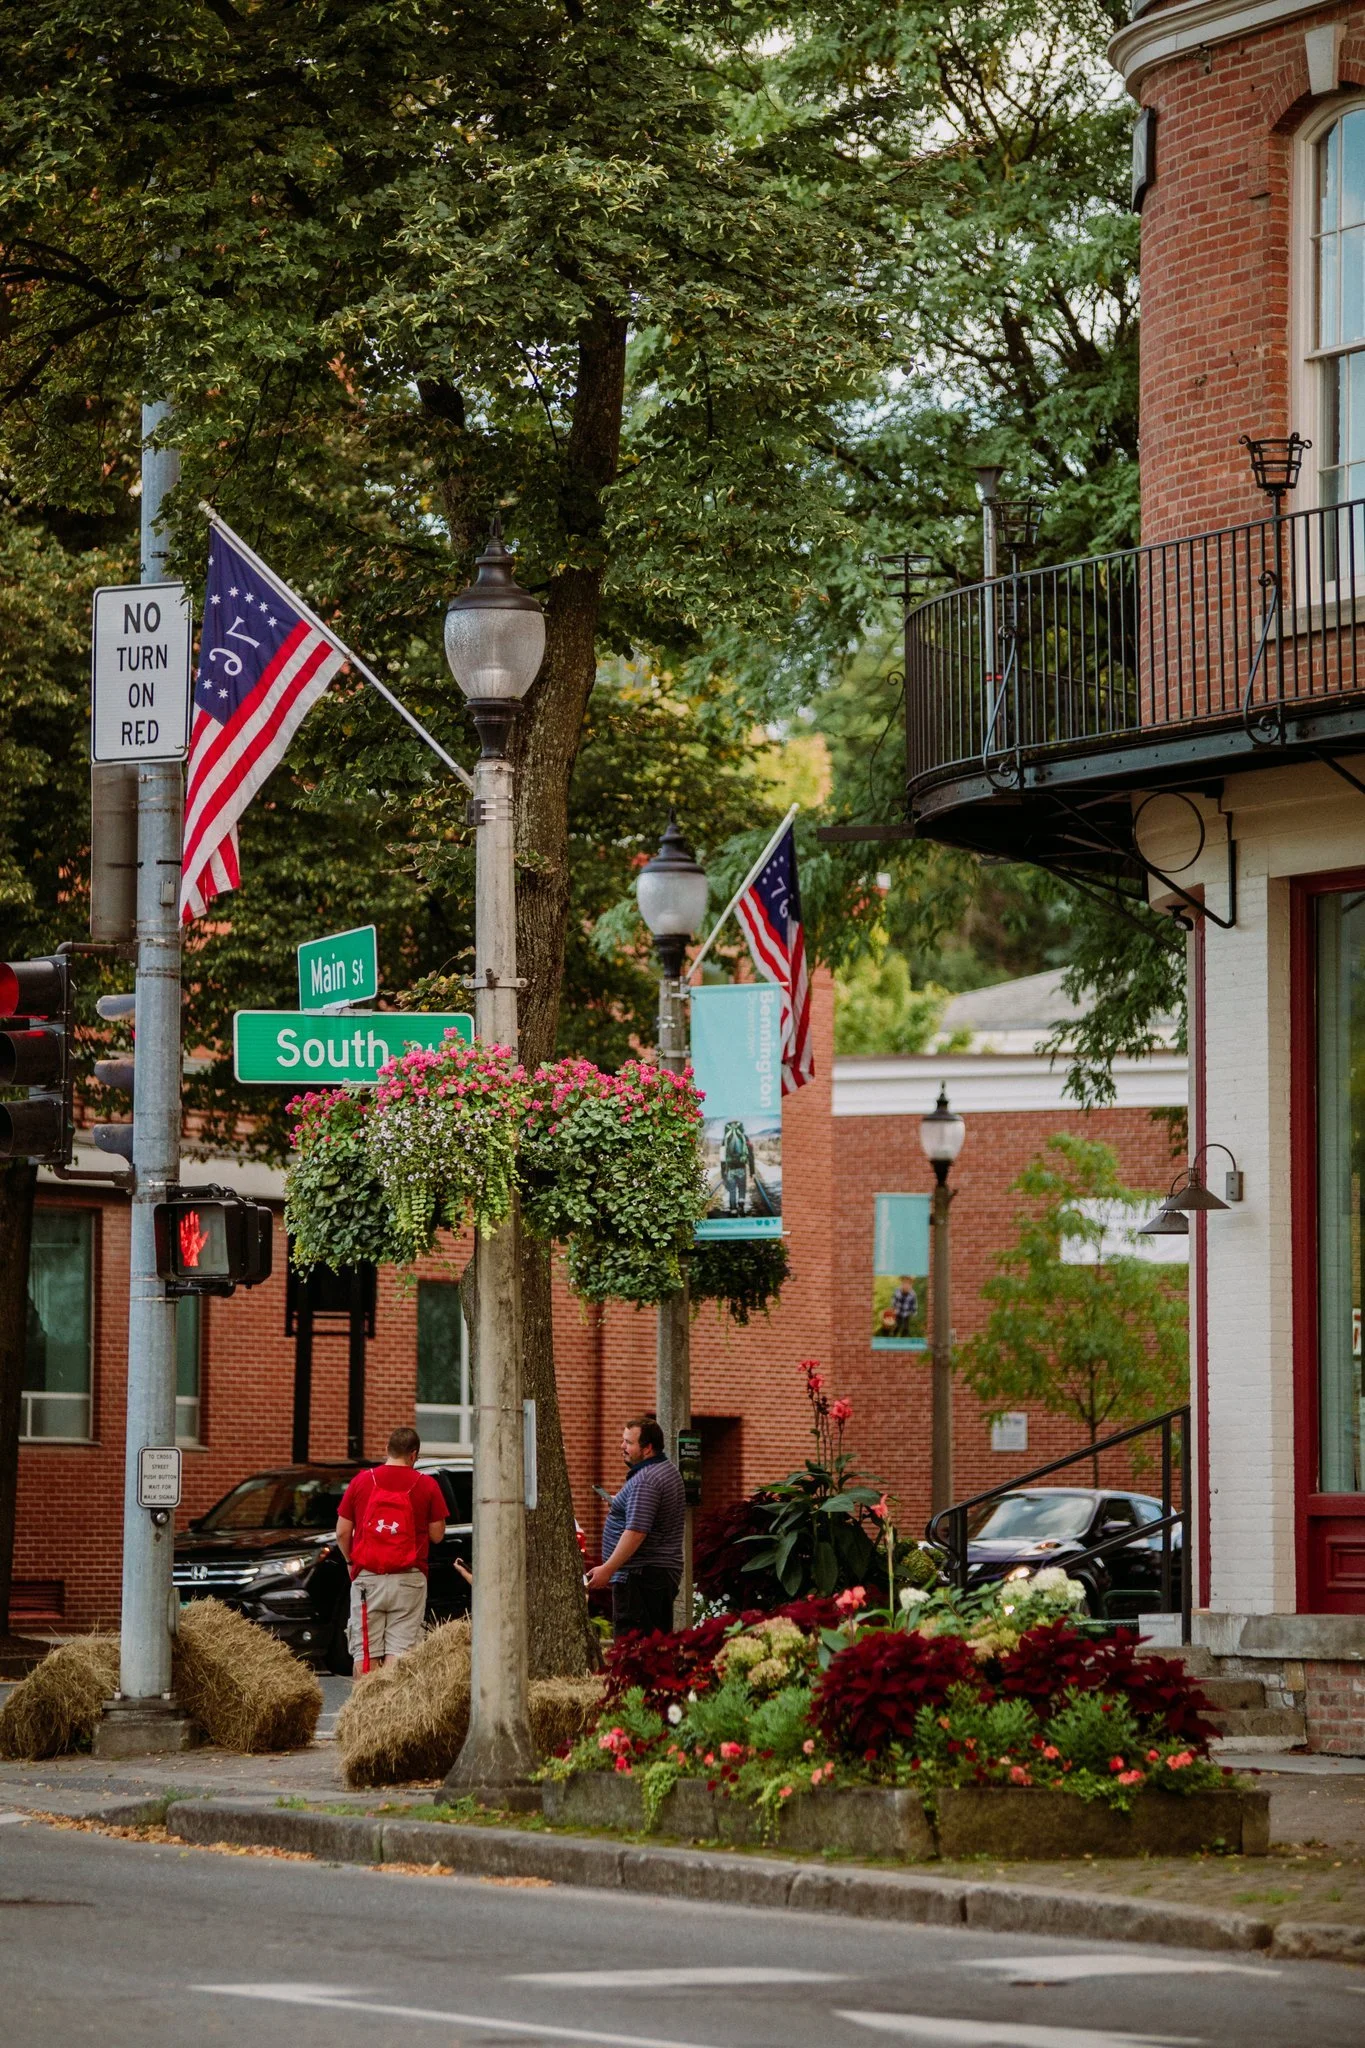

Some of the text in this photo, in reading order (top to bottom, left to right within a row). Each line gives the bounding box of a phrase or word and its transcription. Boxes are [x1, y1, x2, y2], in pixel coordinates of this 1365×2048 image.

[123, 601, 162, 635] NO
[116, 644, 168, 672] TURN
[128, 682, 155, 709] ON
[121, 719, 160, 747] RED
[310, 953, 364, 996] Main St
[276, 1028, 389, 1068] South
[755, 990, 775, 1109] Bennington
